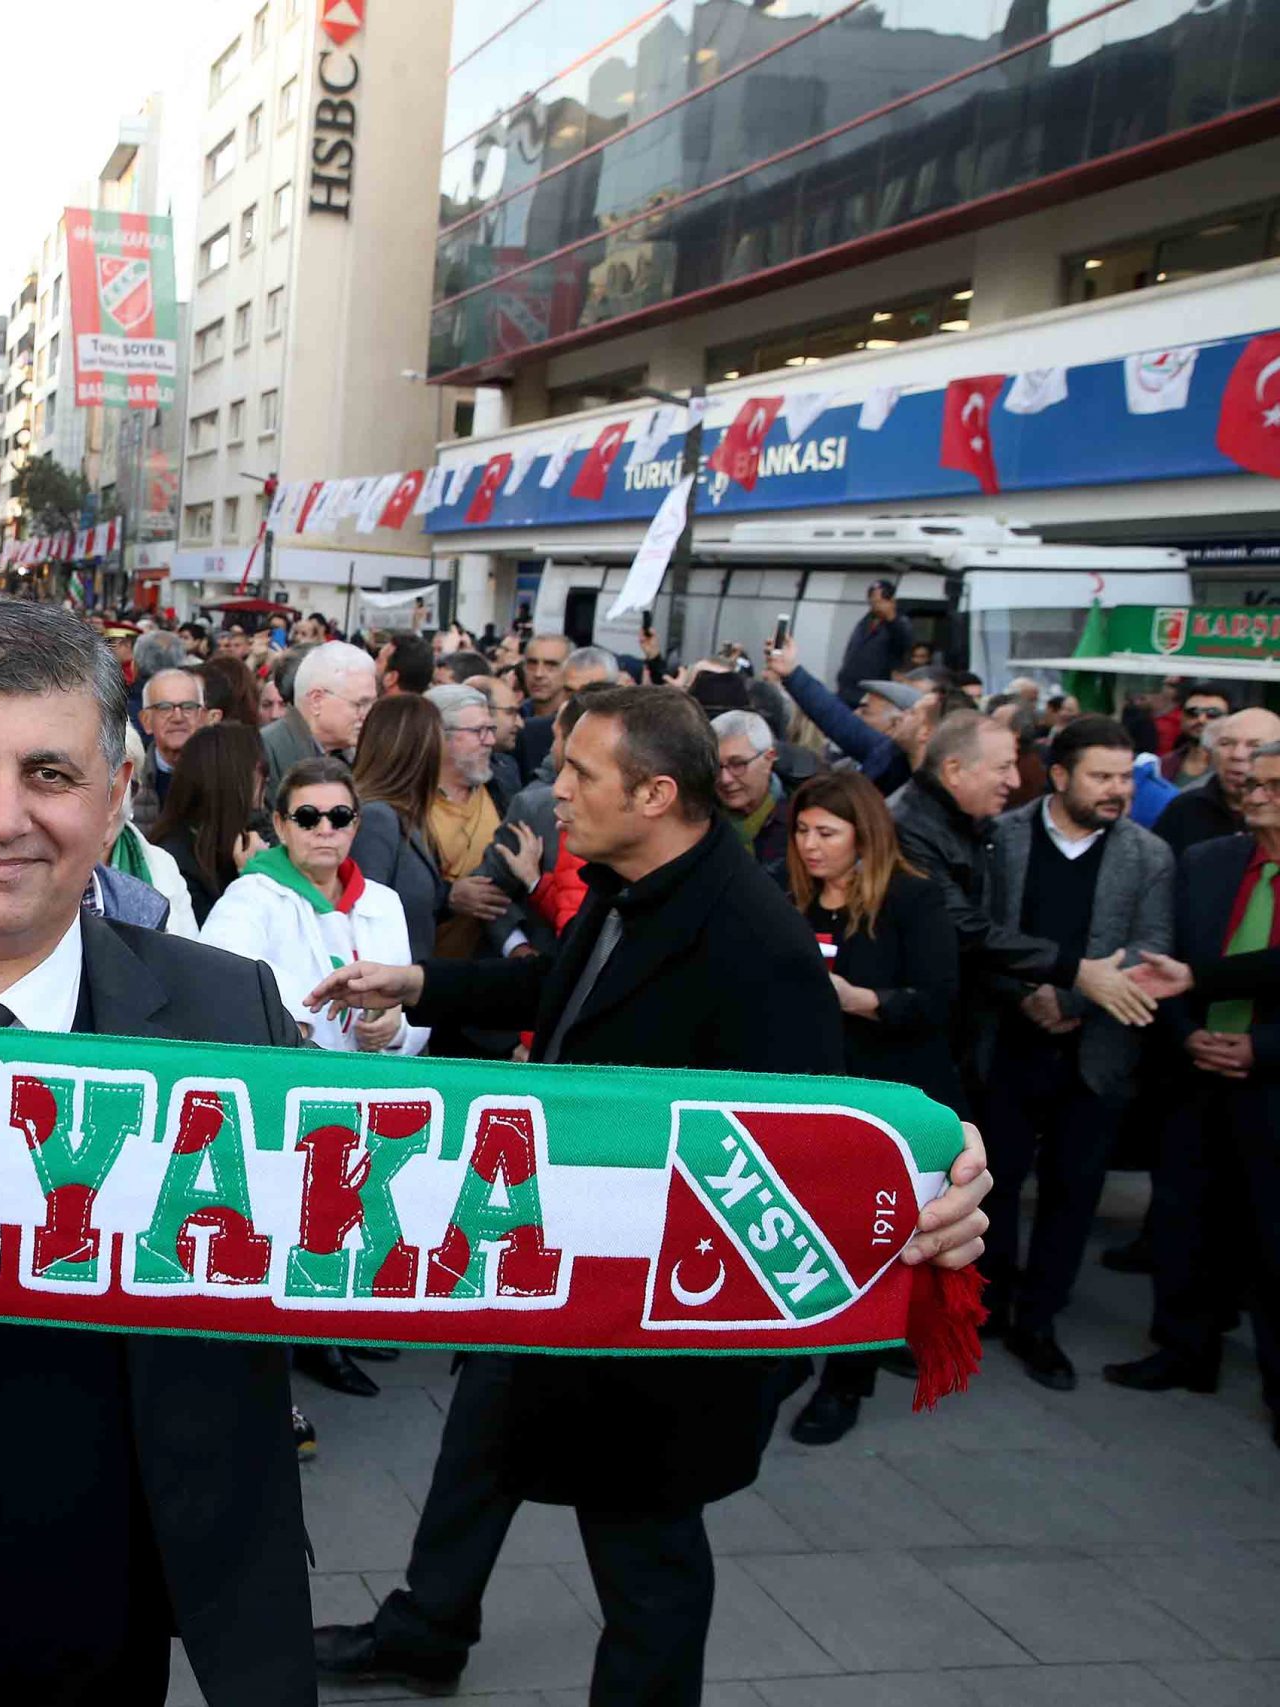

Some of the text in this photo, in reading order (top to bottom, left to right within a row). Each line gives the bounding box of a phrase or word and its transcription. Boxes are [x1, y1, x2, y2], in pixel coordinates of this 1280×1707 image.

[310, 50, 359, 221] HSBC
[91, 339, 166, 357] Tunç SOYER
[703, 1134, 830, 1302] K.S.K.
[871, 1189, 898, 1246] 1912
